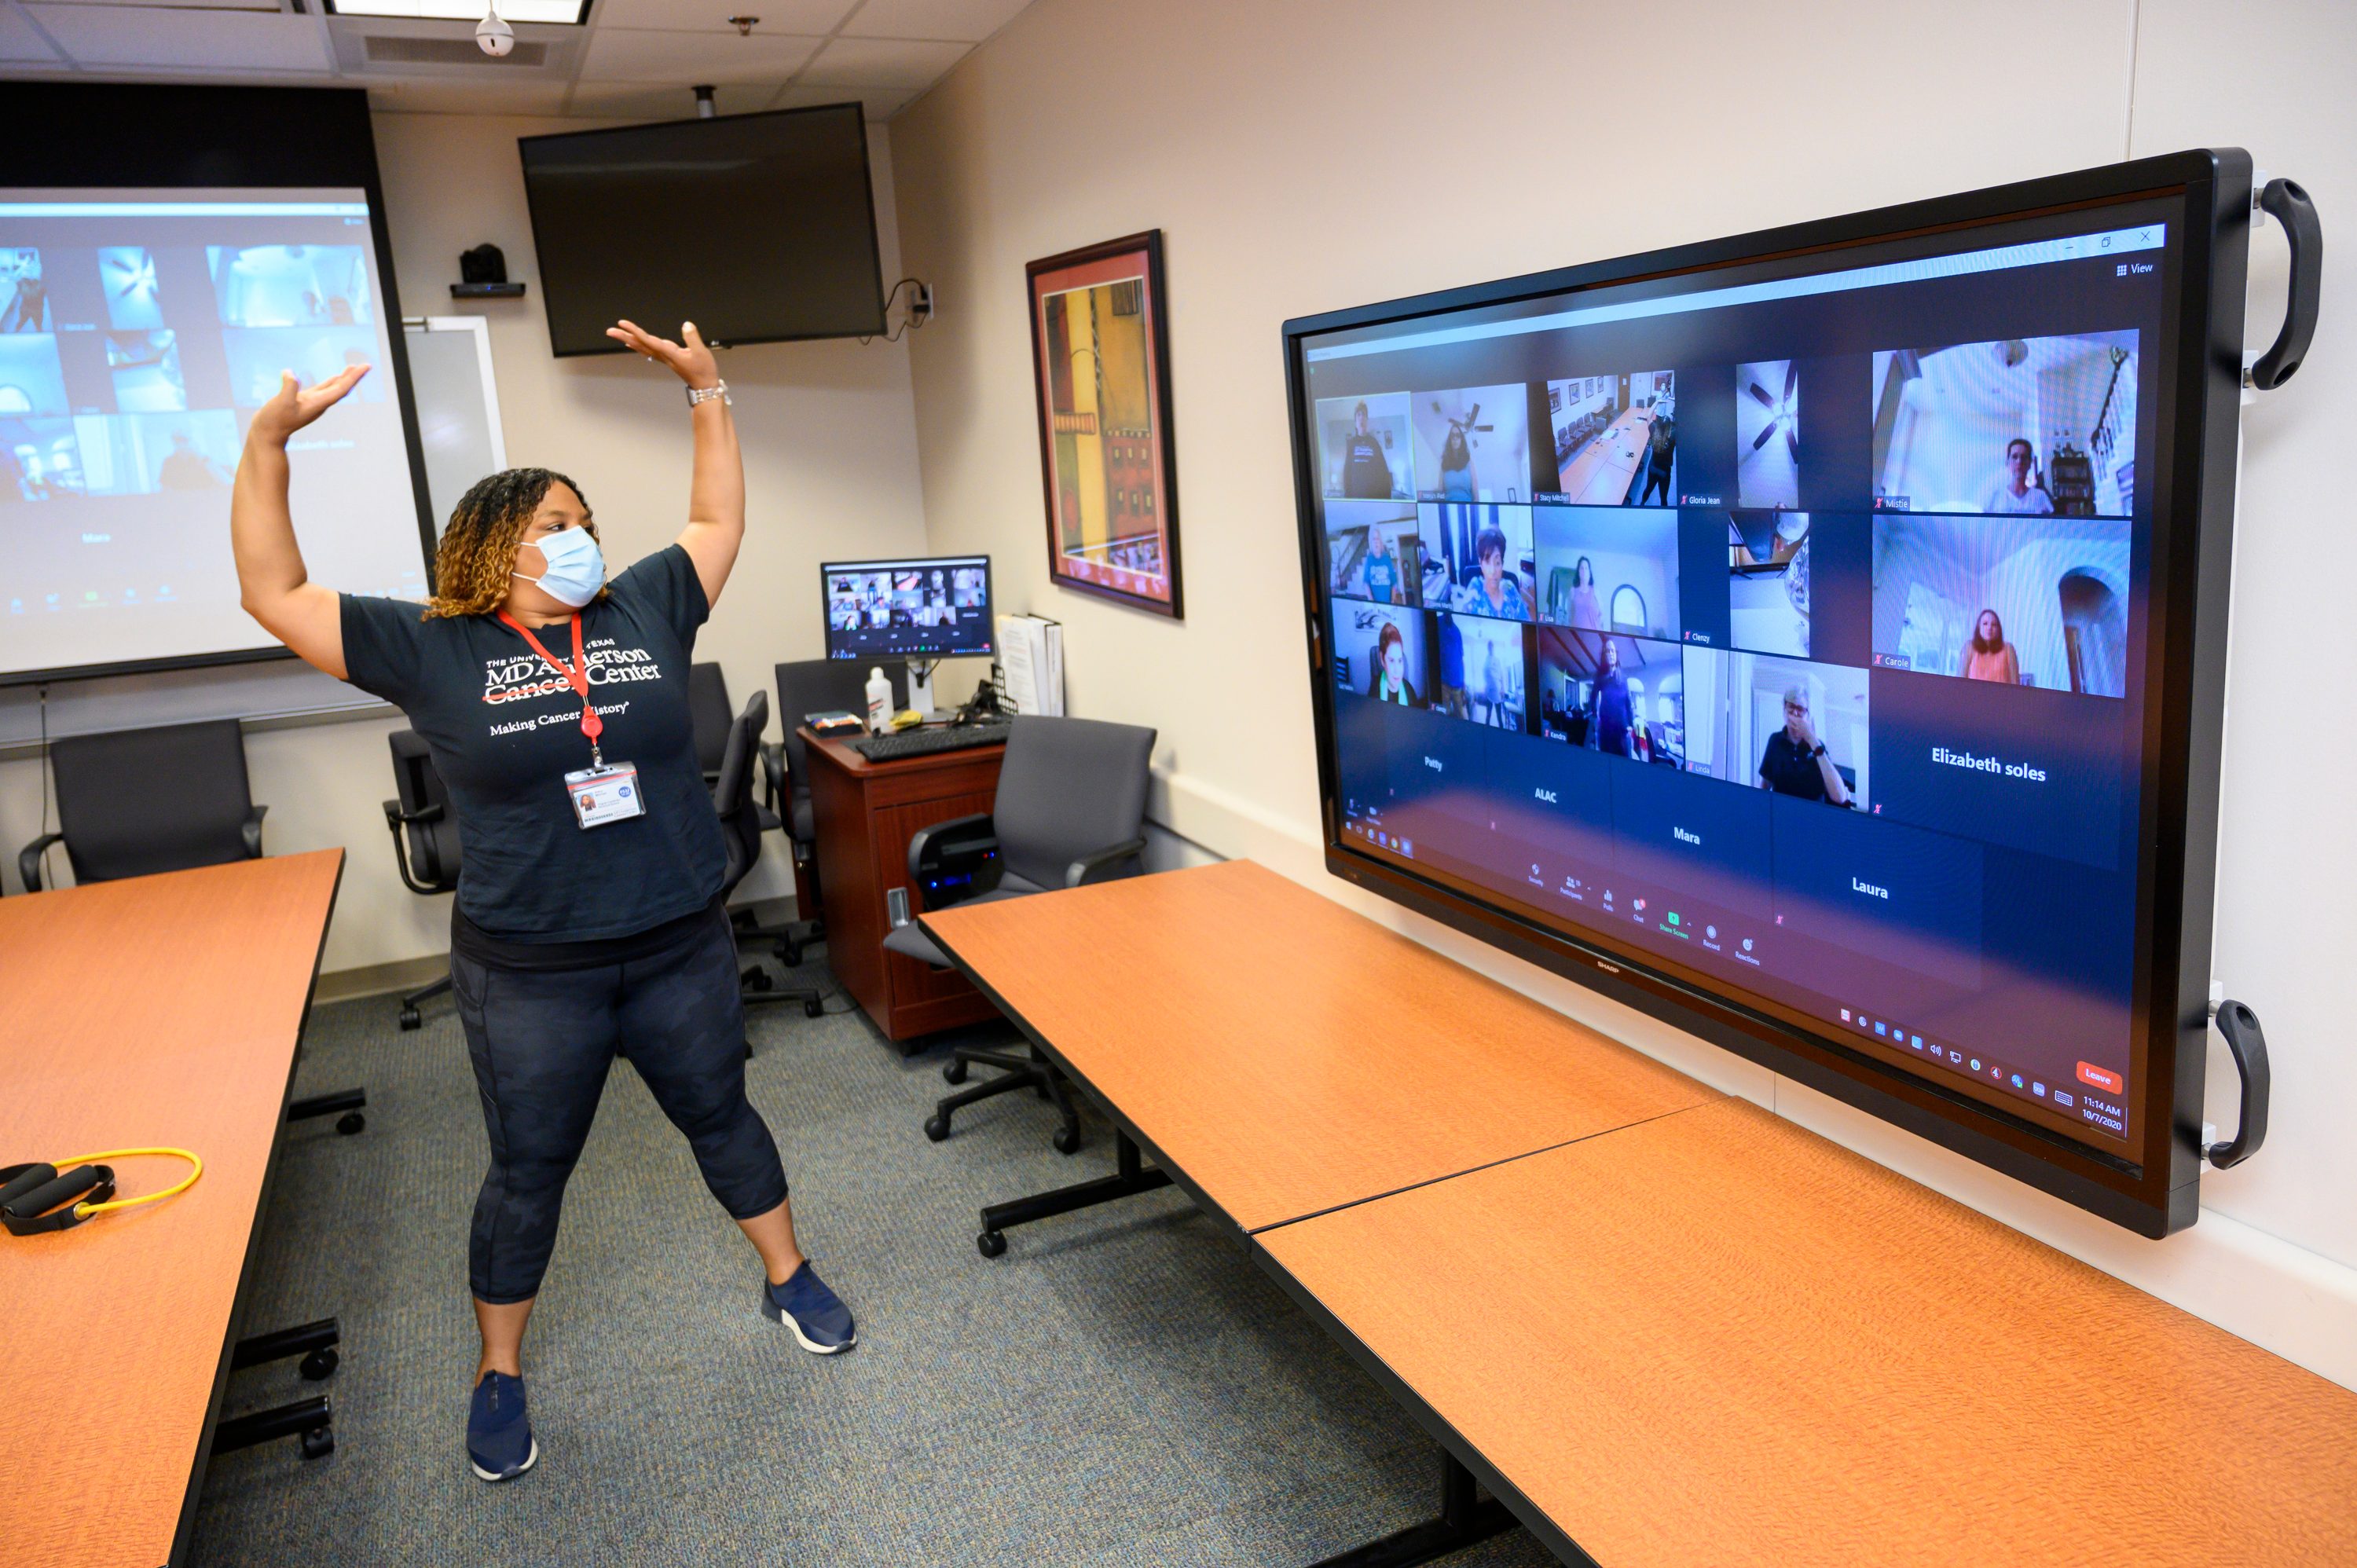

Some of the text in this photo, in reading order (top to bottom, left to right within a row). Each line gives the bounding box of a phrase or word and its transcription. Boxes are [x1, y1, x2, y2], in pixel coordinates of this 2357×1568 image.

[2131, 263, 2153, 274] View
[1540, 494, 1552, 504] Stacy
[1689, 496, 1706, 505] Gloria
[1886, 499, 1908, 508] Mistie
[1545, 614, 1554, 623] Lisa
[1692, 632, 1710, 643] Clenzy
[486, 656, 507, 669] THE
[586, 637, 615, 650] TEXAS
[1885, 657, 1908, 668] Carole
[485, 662, 534, 687] MD
[585, 663, 662, 686] Center
[489, 718, 537, 736] Making
[538, 709, 581, 726] Cancer
[1550, 731, 1567, 742] Kendra
[1424, 757, 1442, 772] Patty
[1695, 764, 1710, 775] Linda
[1932, 747, 2046, 782] Elizabeth soles
[1534, 788, 1557, 804] ALAC
[1673, 826, 1700, 845] Mara
[1560, 887, 1582, 900] Participants
[1853, 877, 1889, 899] Laura
[1603, 902, 1614, 912] Polls
[1633, 914, 1644, 924] Chat
[1659, 923, 1689, 940] Share Screen
[1703, 939, 1721, 951] Record
[1735, 951, 1760, 965] Reactions
[1597, 961, 1619, 974] SHARP
[2085, 1068, 2111, 1085] Leave
[2084, 1096, 2121, 1117] 11:14 AM
[2082, 1108, 2122, 1130] 10/7/2020
